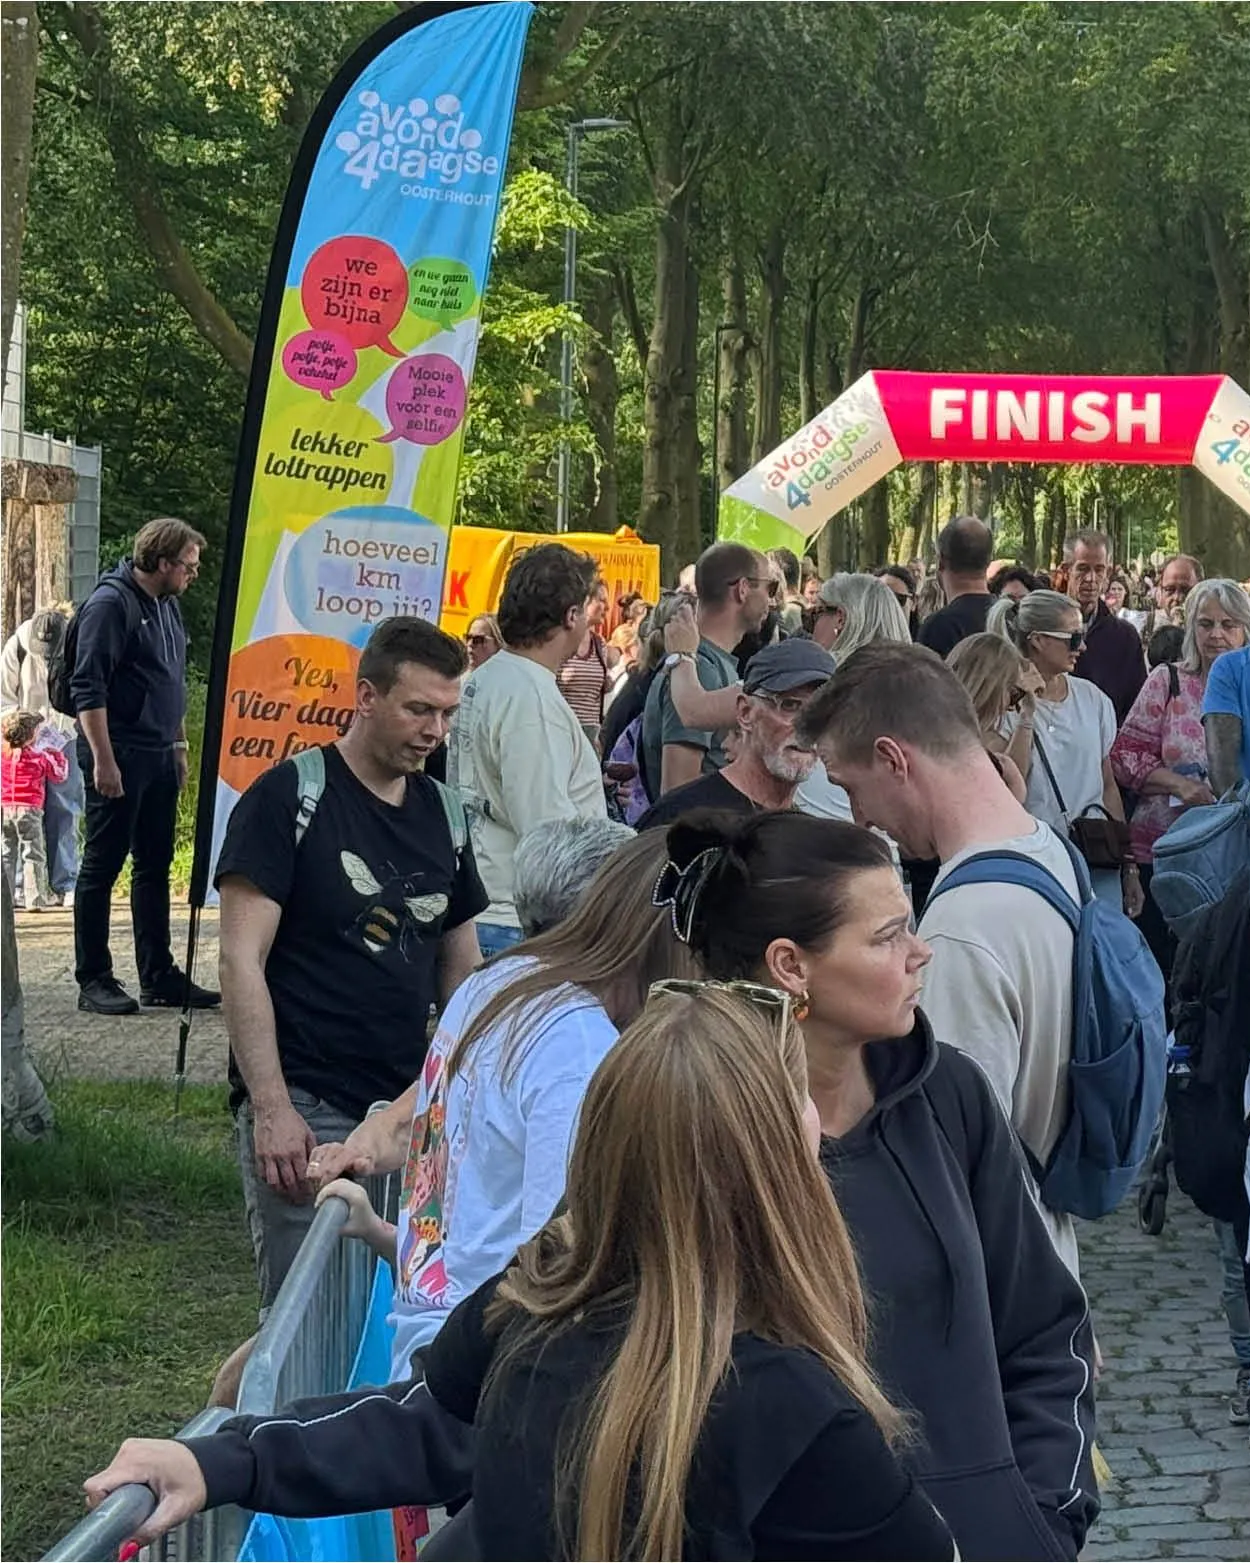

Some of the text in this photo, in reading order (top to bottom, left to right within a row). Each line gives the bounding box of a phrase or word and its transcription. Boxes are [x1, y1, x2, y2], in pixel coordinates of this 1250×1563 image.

[356, 101, 465, 150] avond
[343, 141, 499, 190] 4daagse
[400, 183, 494, 207] OOSTERHOUT
[345, 258, 378, 276] we
[320, 274, 393, 302] zijn er
[413, 296, 440, 309] naar
[323, 296, 382, 325] bijna
[407, 365, 454, 384] Mooie
[411, 383, 446, 401] plek
[396, 402, 457, 418] voor een
[406, 418, 446, 434] selfie
[930, 387, 1162, 444] FINISH
[290, 427, 369, 459] lekker
[767, 424, 833, 488] avond
[263, 452, 387, 492] loltrappen
[786, 421, 870, 511] 4daagse
[824, 440, 883, 491] OOSTERHOUT
[322, 529, 439, 566] hoeveel
[355, 563, 401, 591] km
[449, 569, 471, 609] K
[315, 587, 384, 624] loop
[285, 657, 338, 693] Yes,
[230, 689, 355, 738] Vier dag
[229, 736, 276, 759] een
